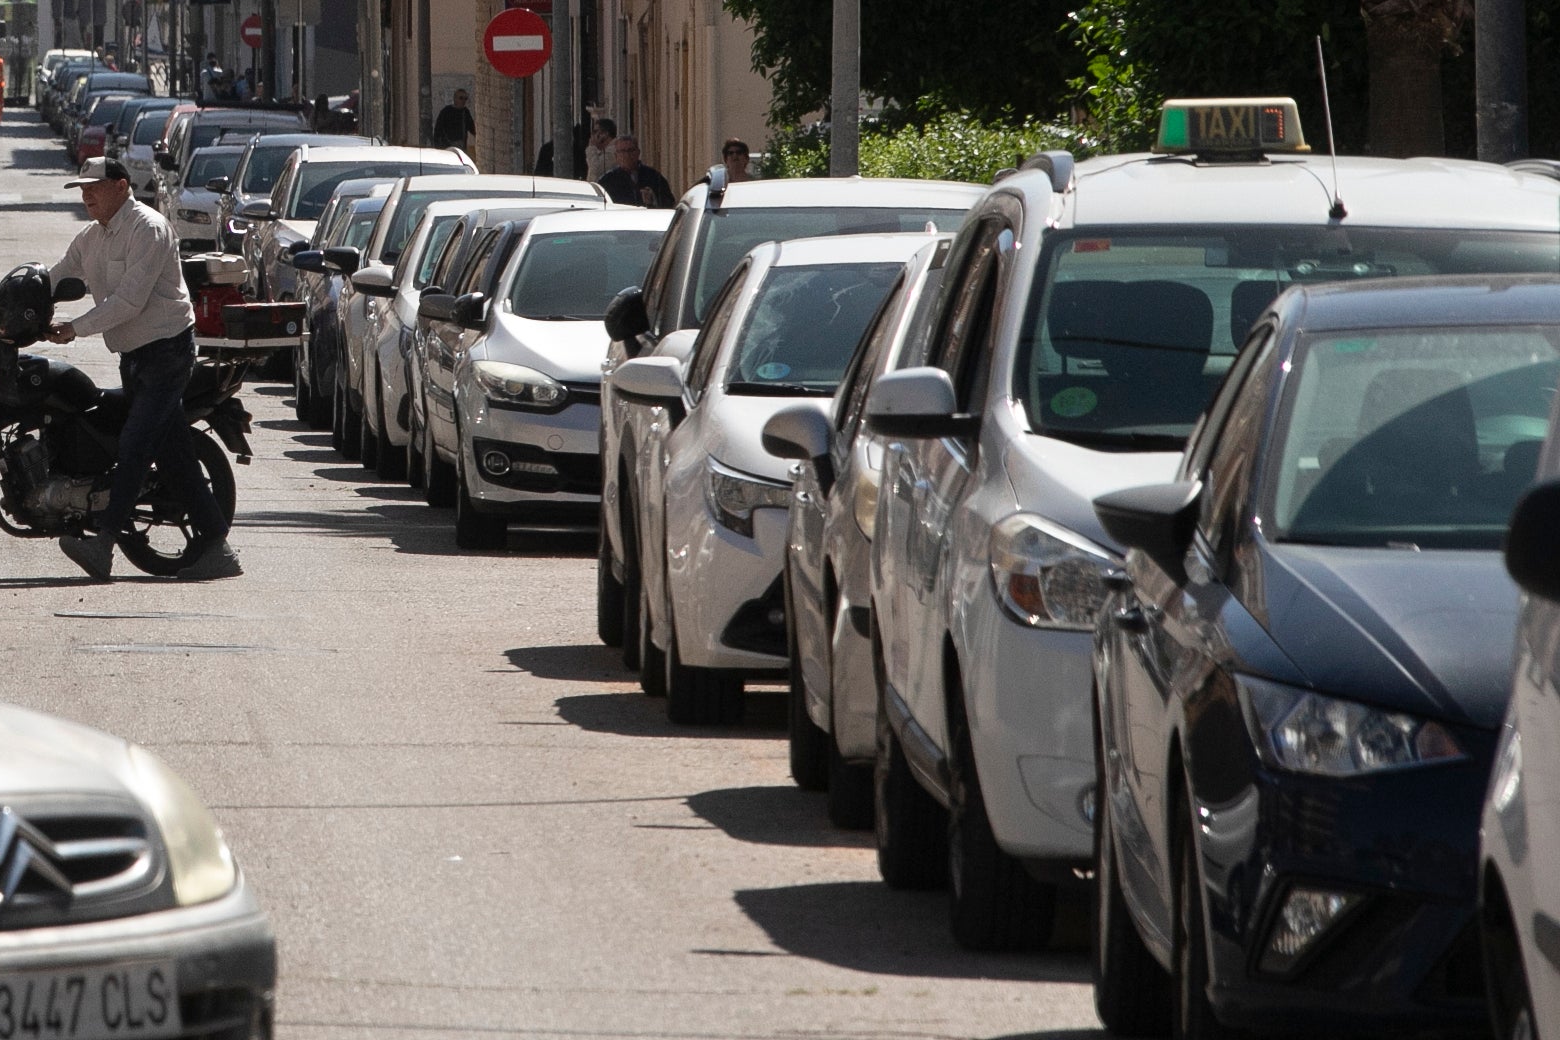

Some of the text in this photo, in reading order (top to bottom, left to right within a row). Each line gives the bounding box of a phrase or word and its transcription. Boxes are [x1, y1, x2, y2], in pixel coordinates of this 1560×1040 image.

[1195, 107, 1284, 139] TAXI 7
[101, 968, 168, 1032] CLS
